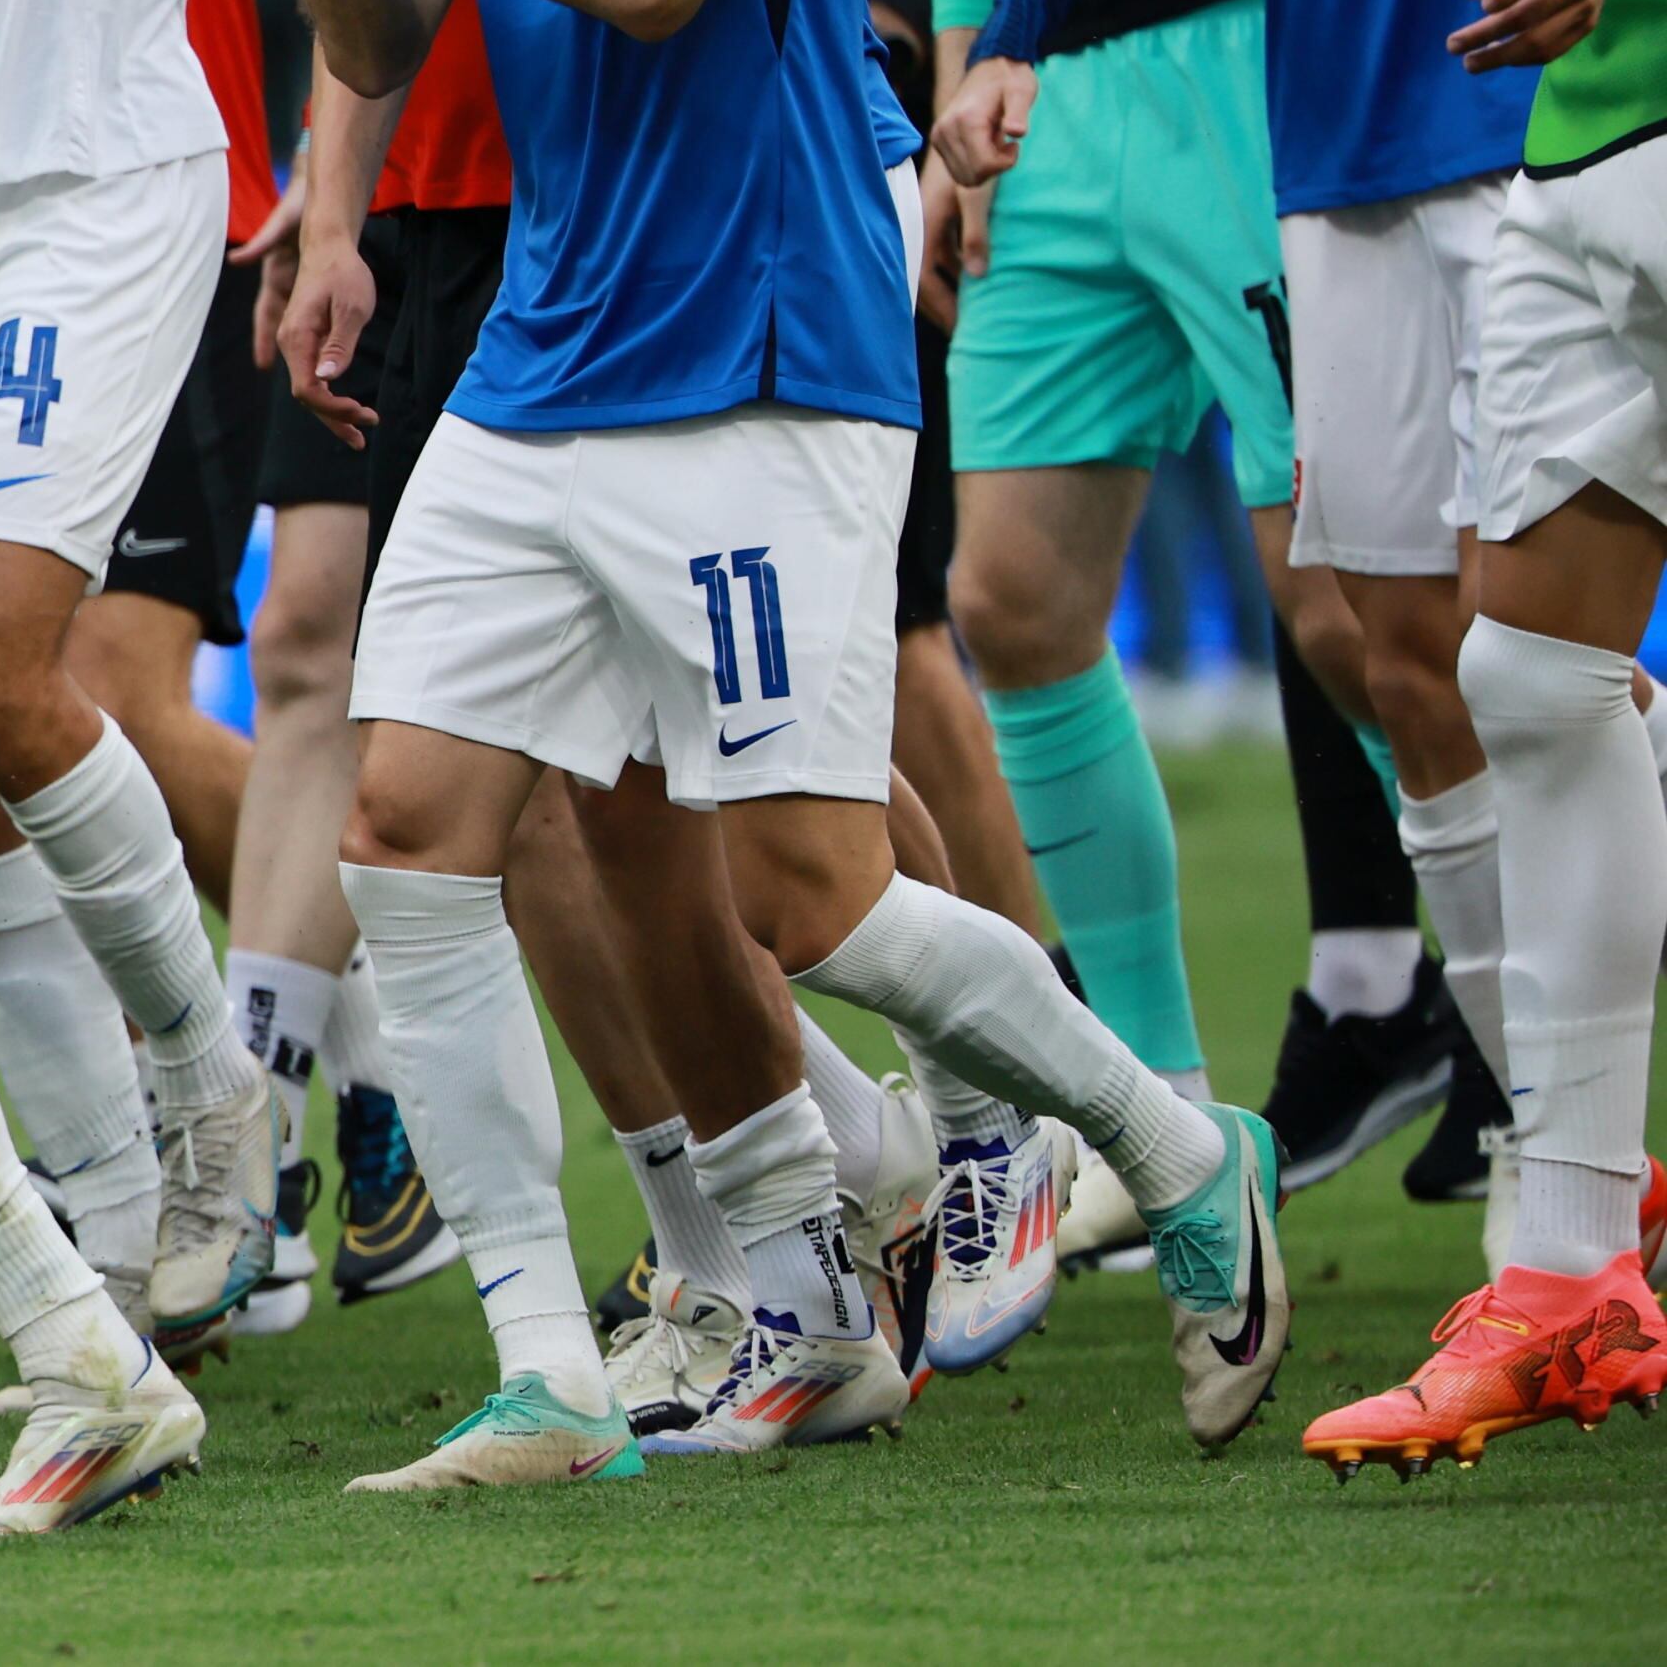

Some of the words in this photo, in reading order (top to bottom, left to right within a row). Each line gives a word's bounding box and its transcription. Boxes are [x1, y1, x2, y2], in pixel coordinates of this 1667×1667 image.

[1243, 272, 1295, 418] 1
[689, 546, 791, 705] 11
[809, 1232, 851, 1330] TAPEDESIGN
